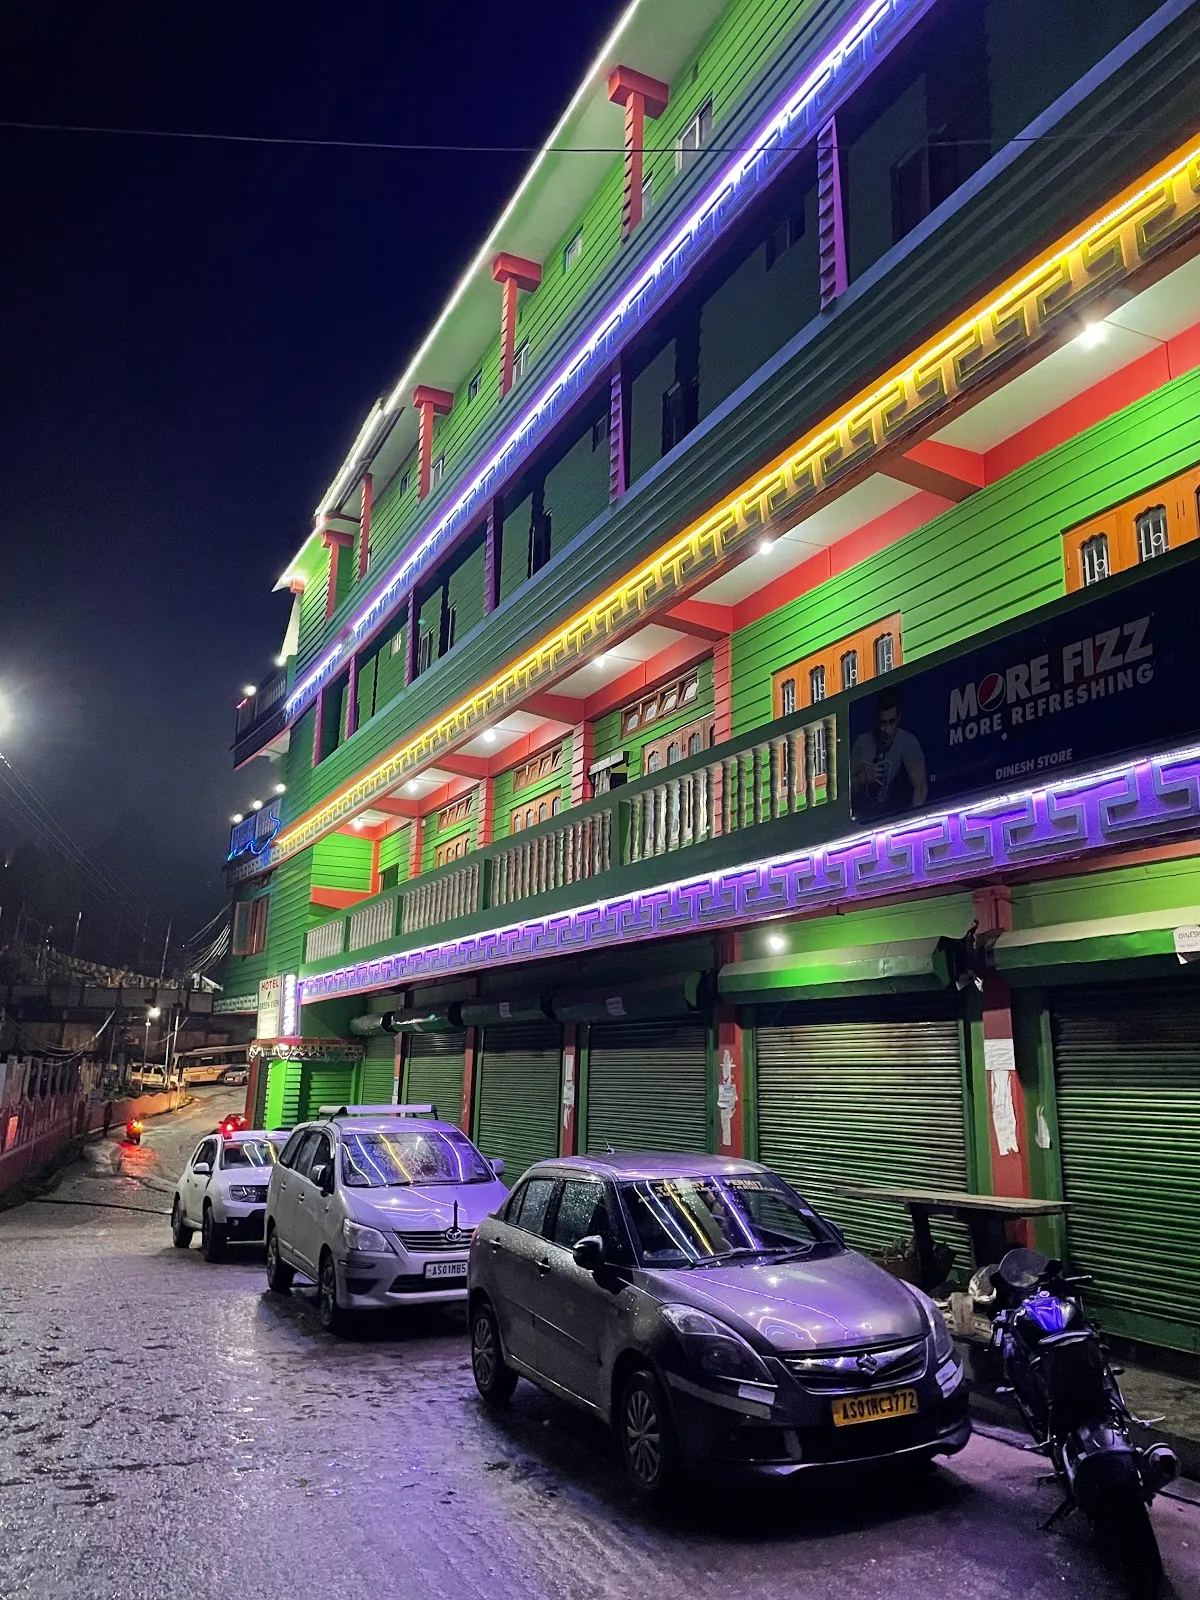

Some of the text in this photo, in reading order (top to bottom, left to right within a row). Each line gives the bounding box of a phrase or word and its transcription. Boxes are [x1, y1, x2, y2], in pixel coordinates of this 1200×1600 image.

[949, 615, 1153, 724] MORE FIZZ
[949, 663, 1154, 746] MORE REFRESHING
[995, 748, 1073, 780] DINESH STORE
[261, 979, 279, 991] HOTEL
[724, 1179, 762, 1190] PERMIT
